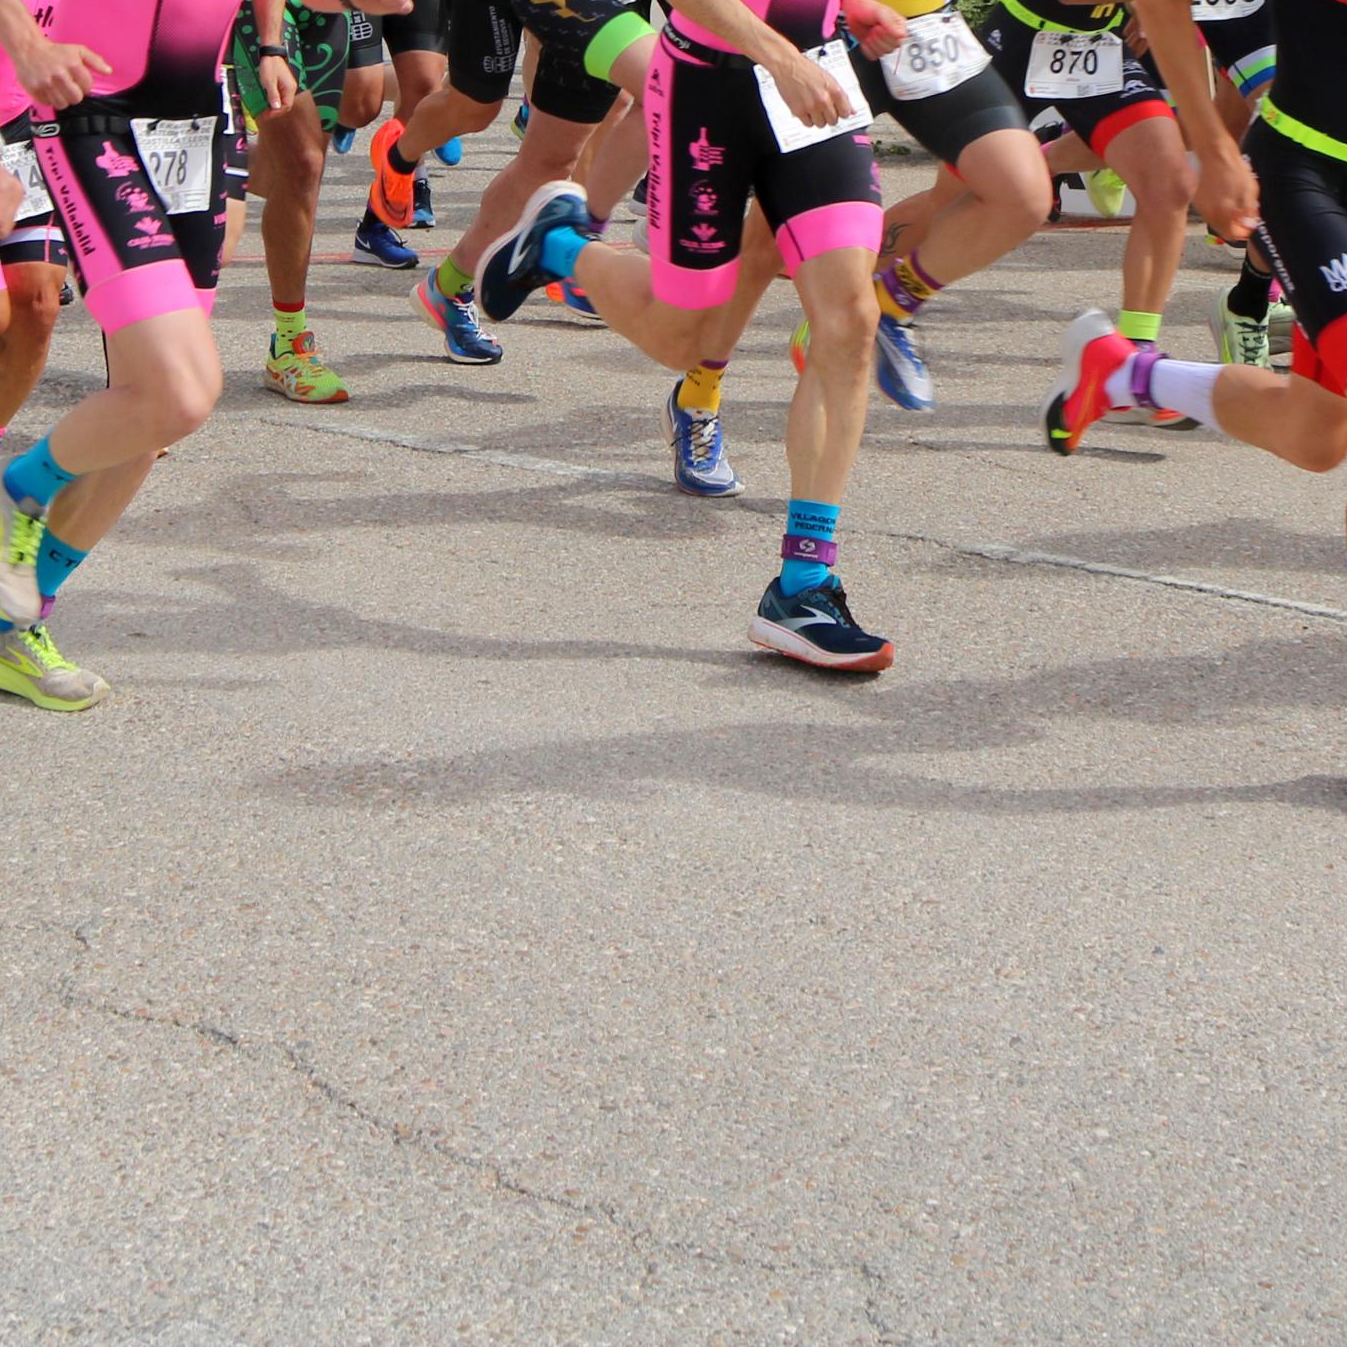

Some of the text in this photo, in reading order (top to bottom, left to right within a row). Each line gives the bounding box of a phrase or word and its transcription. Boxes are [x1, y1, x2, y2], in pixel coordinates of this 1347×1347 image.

[907, 33, 960, 73] 850
[1049, 48, 1098, 76] 870
[148, 148, 189, 187] 278
[59, 185, 97, 257] Valladolid
